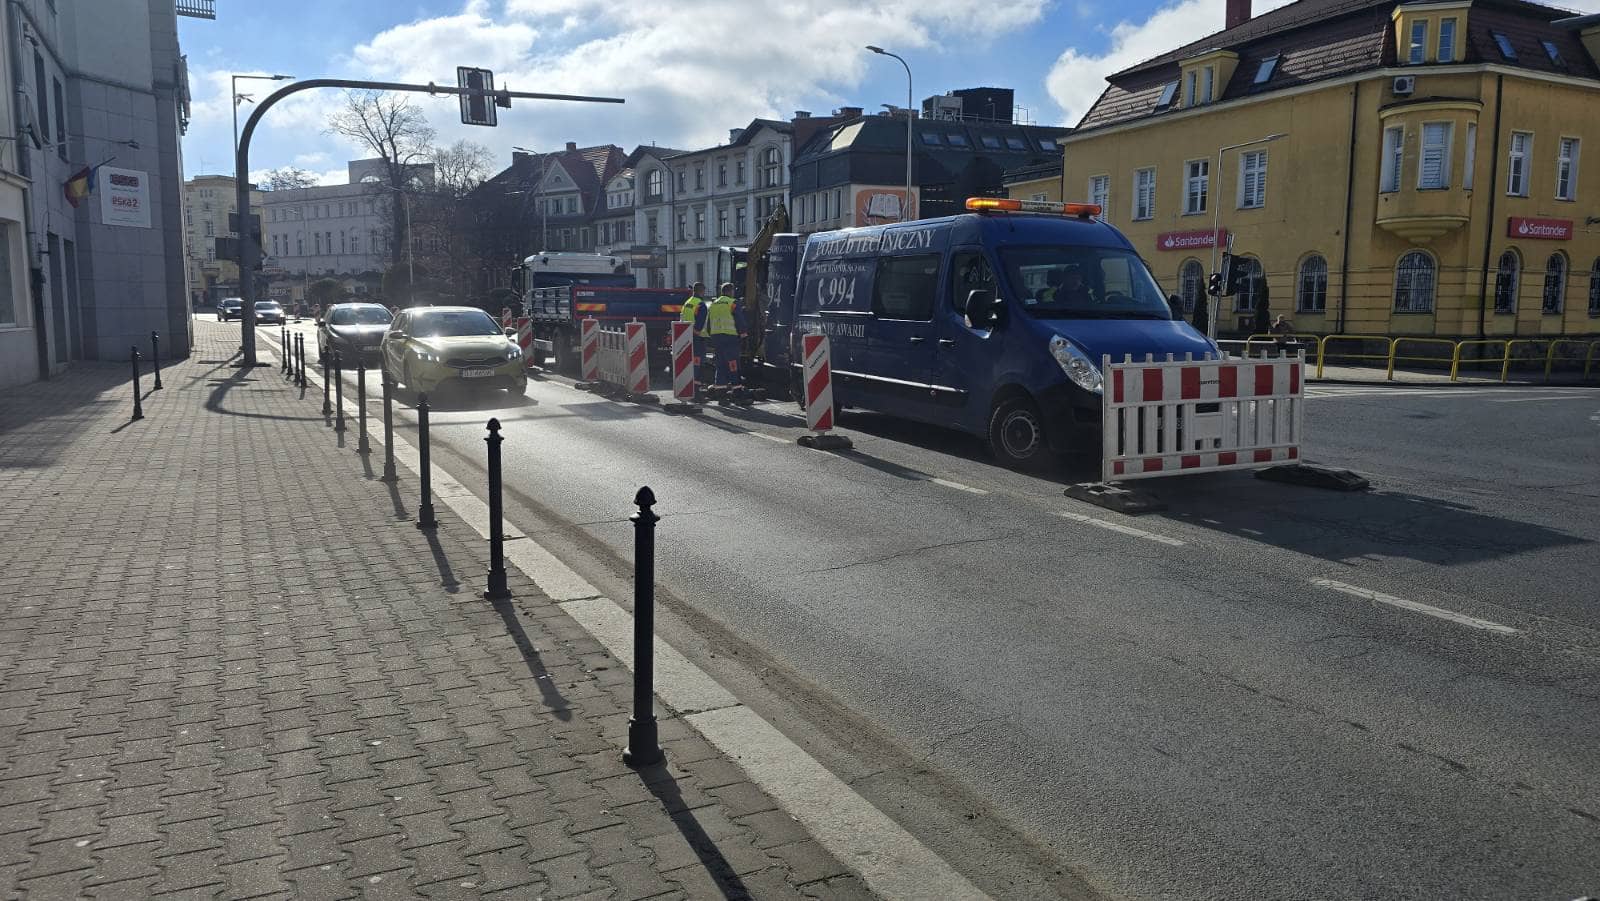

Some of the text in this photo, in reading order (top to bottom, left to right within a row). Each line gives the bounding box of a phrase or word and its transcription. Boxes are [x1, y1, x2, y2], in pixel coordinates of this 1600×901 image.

[1529, 223, 1567, 236] Santander
[815, 237, 854, 256] POJAZD
[855, 229, 936, 253] TECHNICZNY
[1175, 236, 1216, 247] Santande
[766, 282, 782, 308] 94
[827, 276, 856, 305] 994
[836, 323, 865, 338] AWARII
